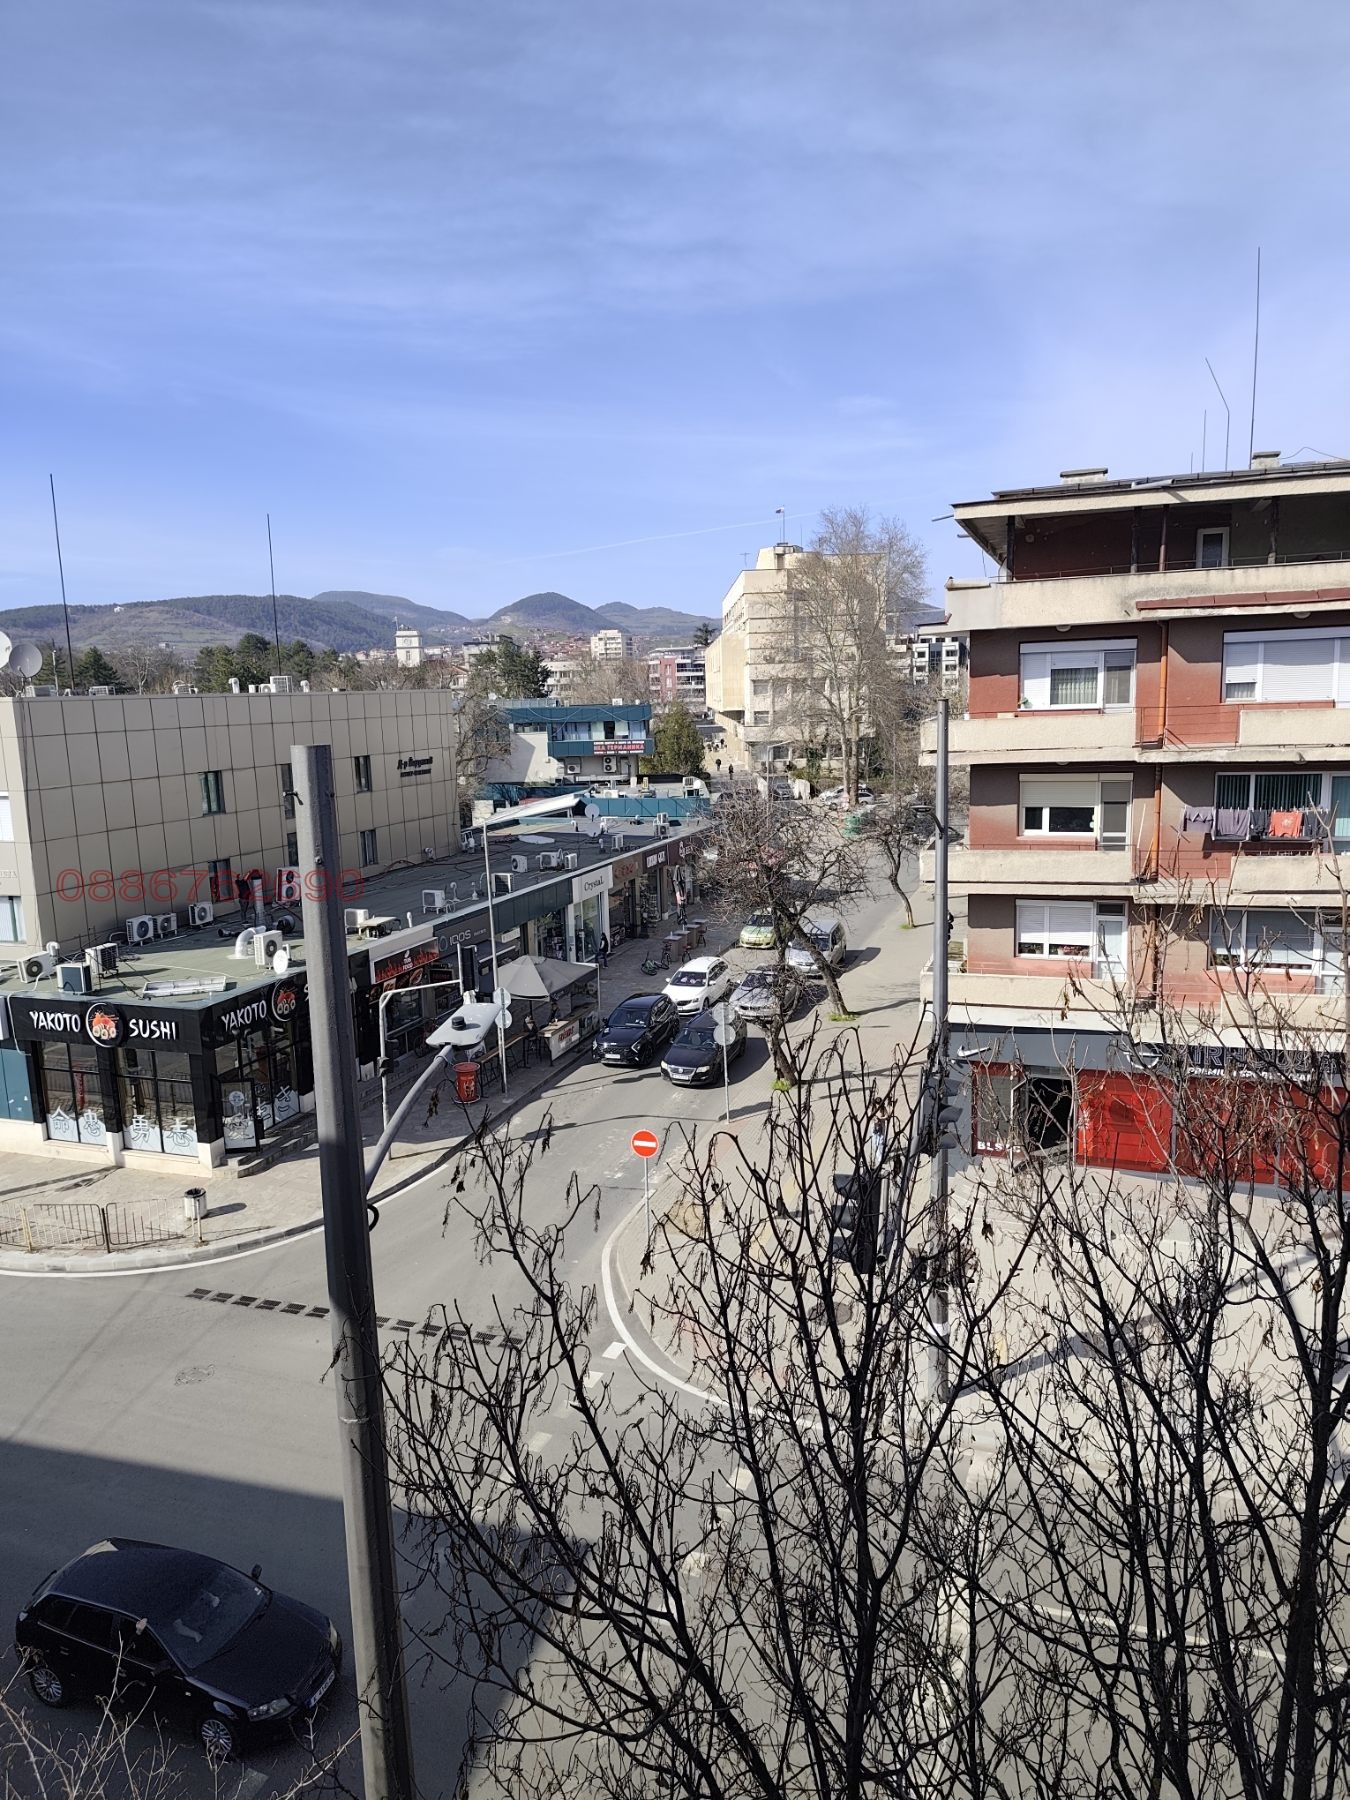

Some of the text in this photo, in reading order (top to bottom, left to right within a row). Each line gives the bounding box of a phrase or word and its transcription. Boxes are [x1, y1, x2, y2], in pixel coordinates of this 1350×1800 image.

[449, 929, 472, 946] IQOS
[29, 1011, 177, 1040] YAKOTO SUSHI
[221, 1000, 267, 1032] YAKOTO
